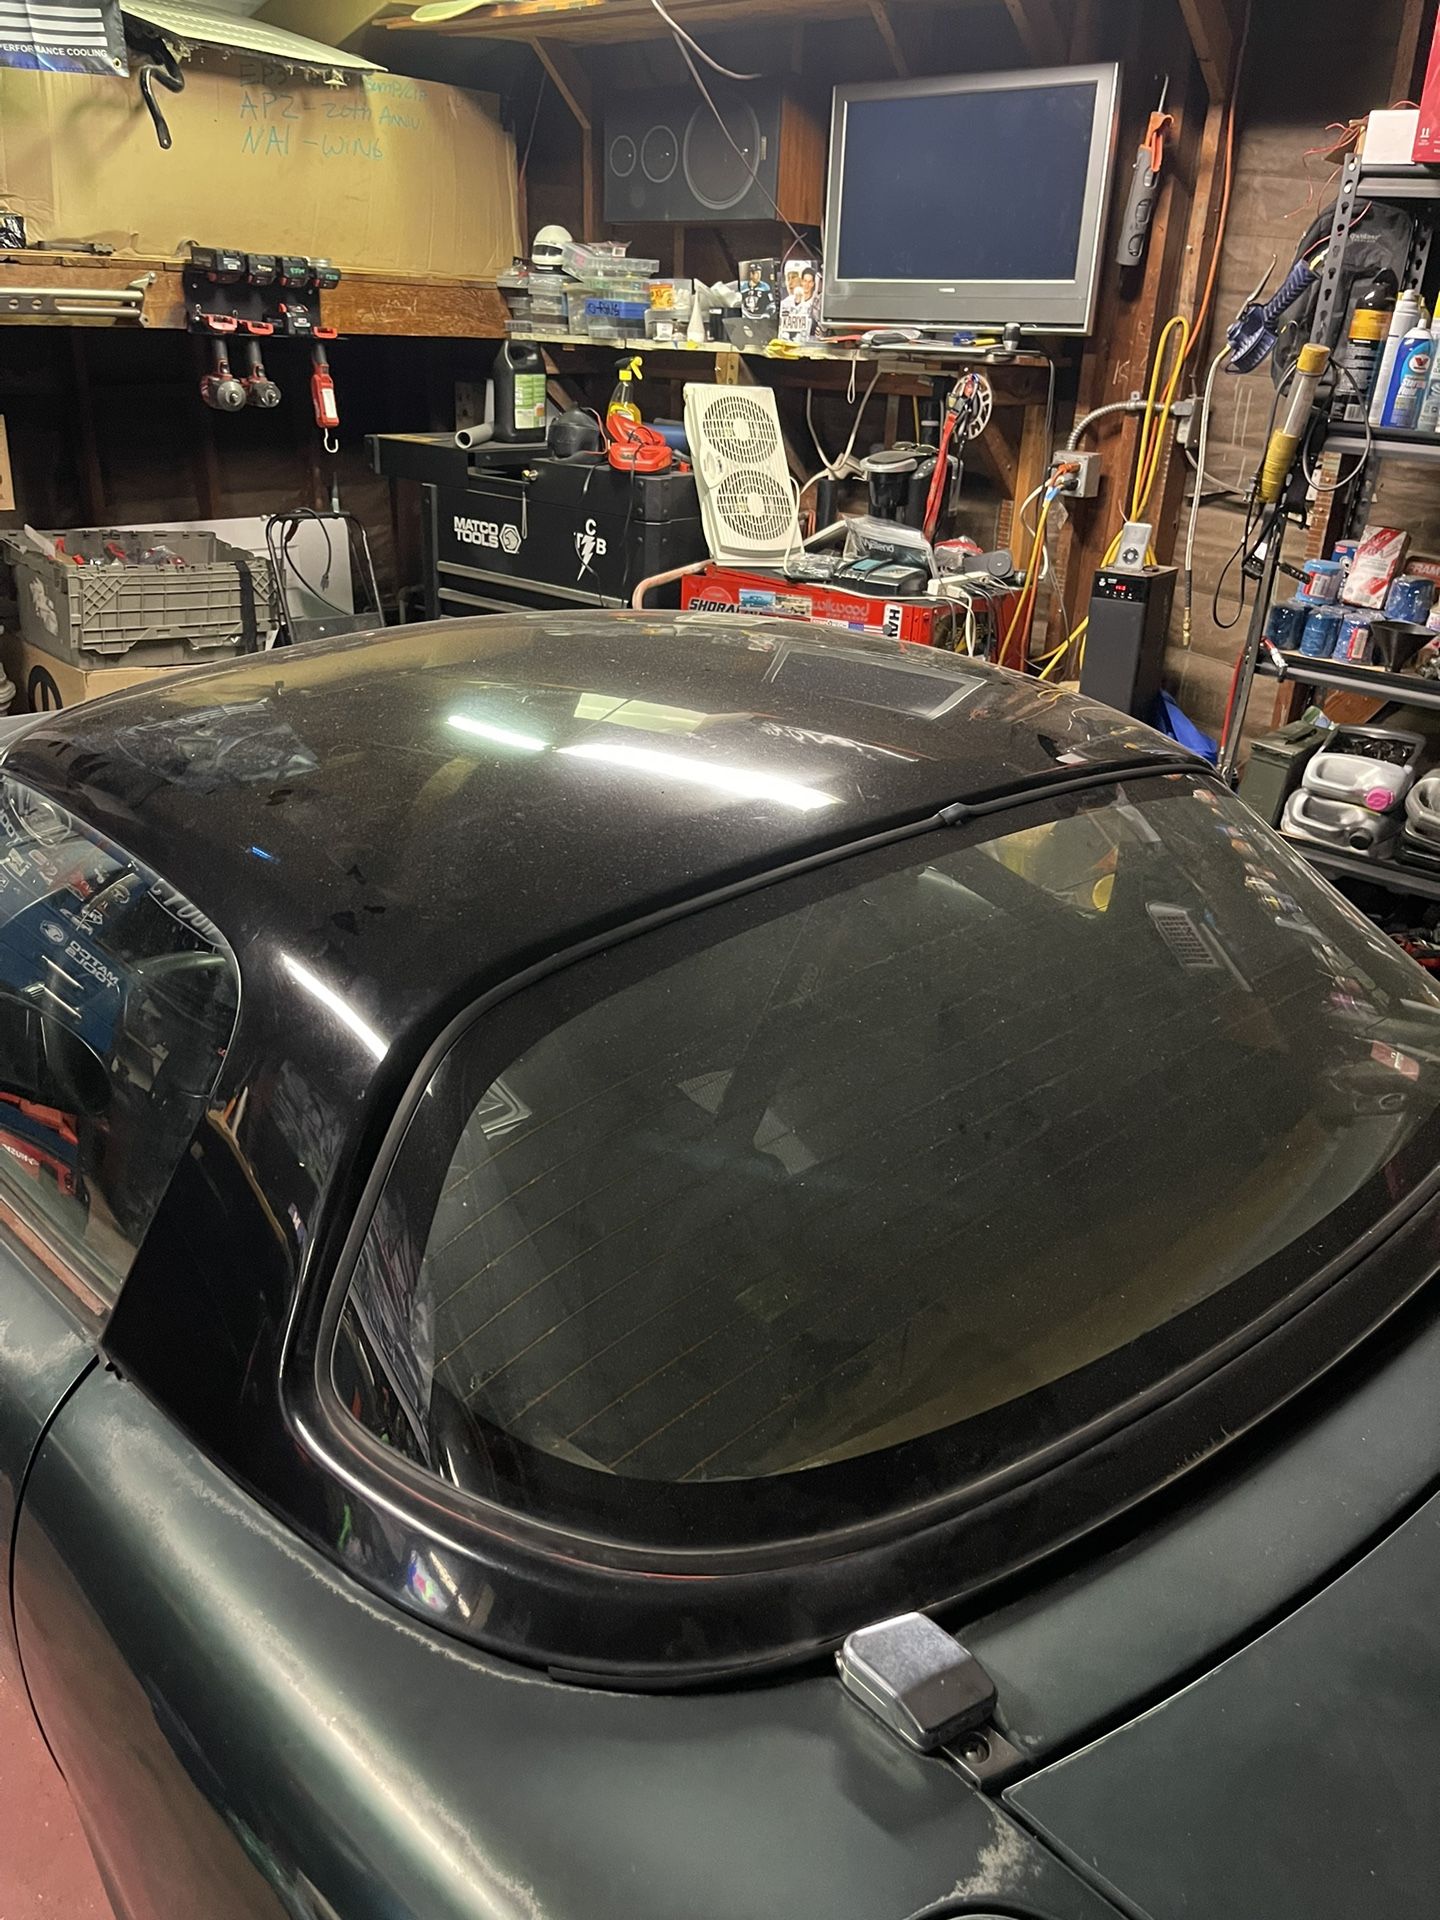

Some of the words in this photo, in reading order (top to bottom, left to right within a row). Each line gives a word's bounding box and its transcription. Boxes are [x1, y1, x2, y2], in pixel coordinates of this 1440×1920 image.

[66, 47, 108, 58] COOLING
[453, 515, 499, 536] MATCO
[454, 527, 499, 549] TOOLS
